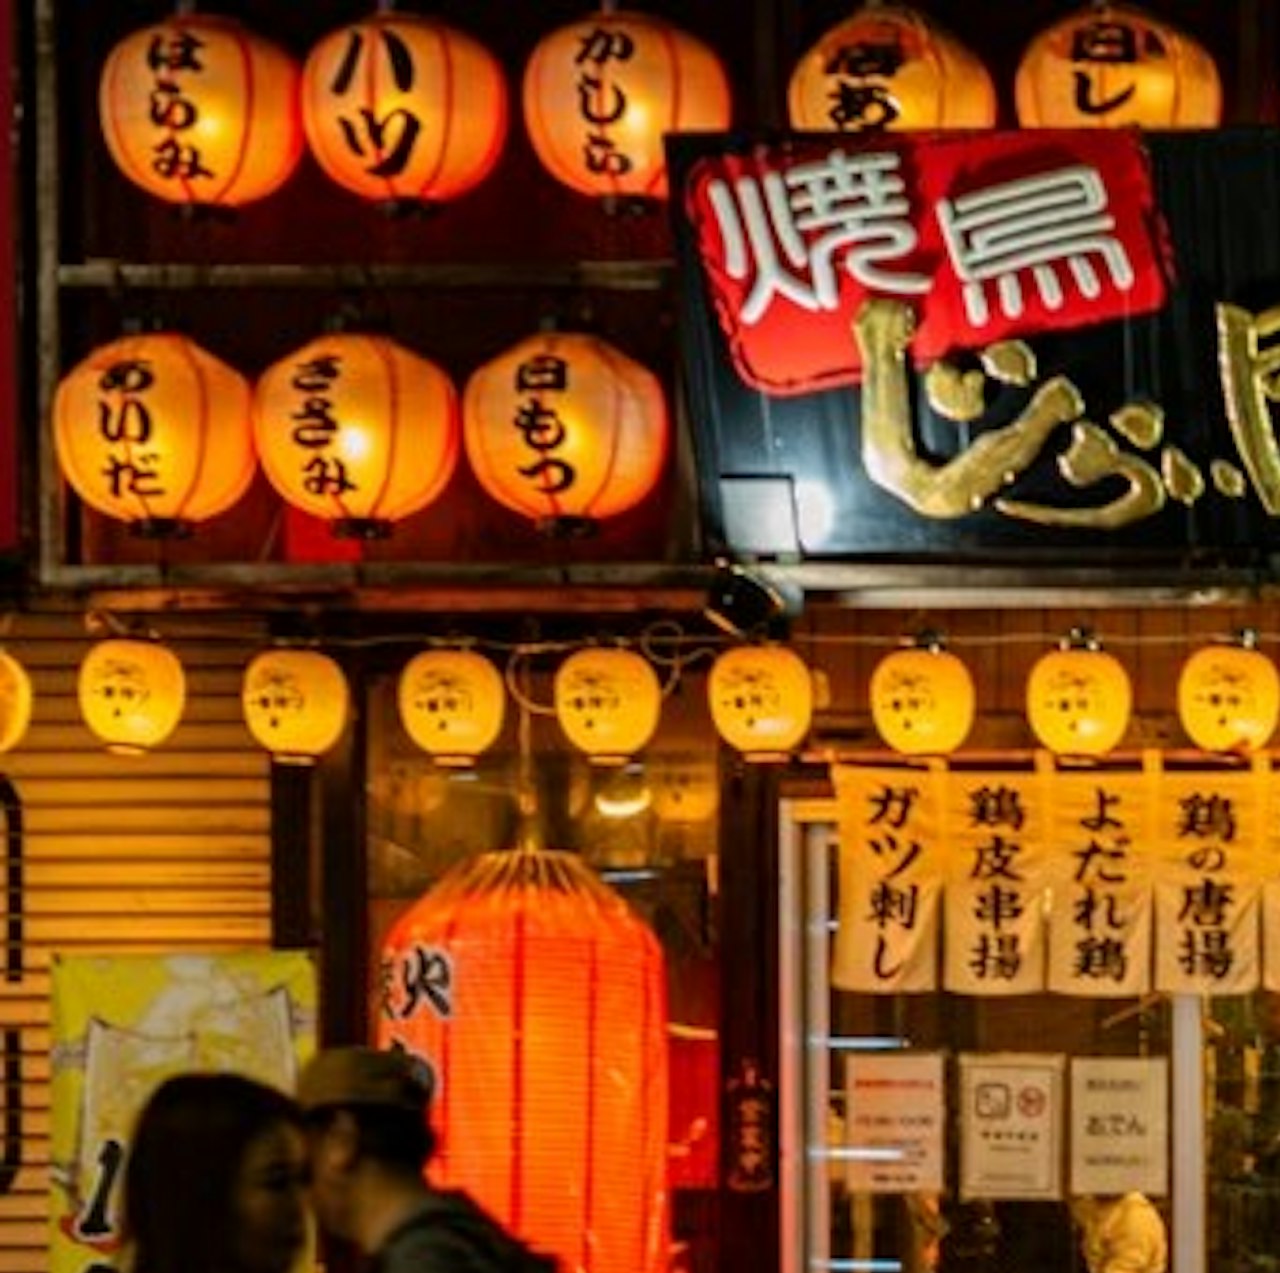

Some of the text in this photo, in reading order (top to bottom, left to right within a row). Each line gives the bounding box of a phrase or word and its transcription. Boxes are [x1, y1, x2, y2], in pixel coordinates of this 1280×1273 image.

[146, 32, 214, 181] はらみ
[330, 28, 422, 178] ハツ
[573, 27, 636, 177] かしら
[708, 148, 1136, 326] 焼鳥
[866, 783, 921, 984] ガツ刺し
[967, 783, 1024, 984] 鶏皮串揚
[1073, 788, 1129, 984] よだれ鶏
[1176, 793, 1237, 983] 鶏の唐揚
